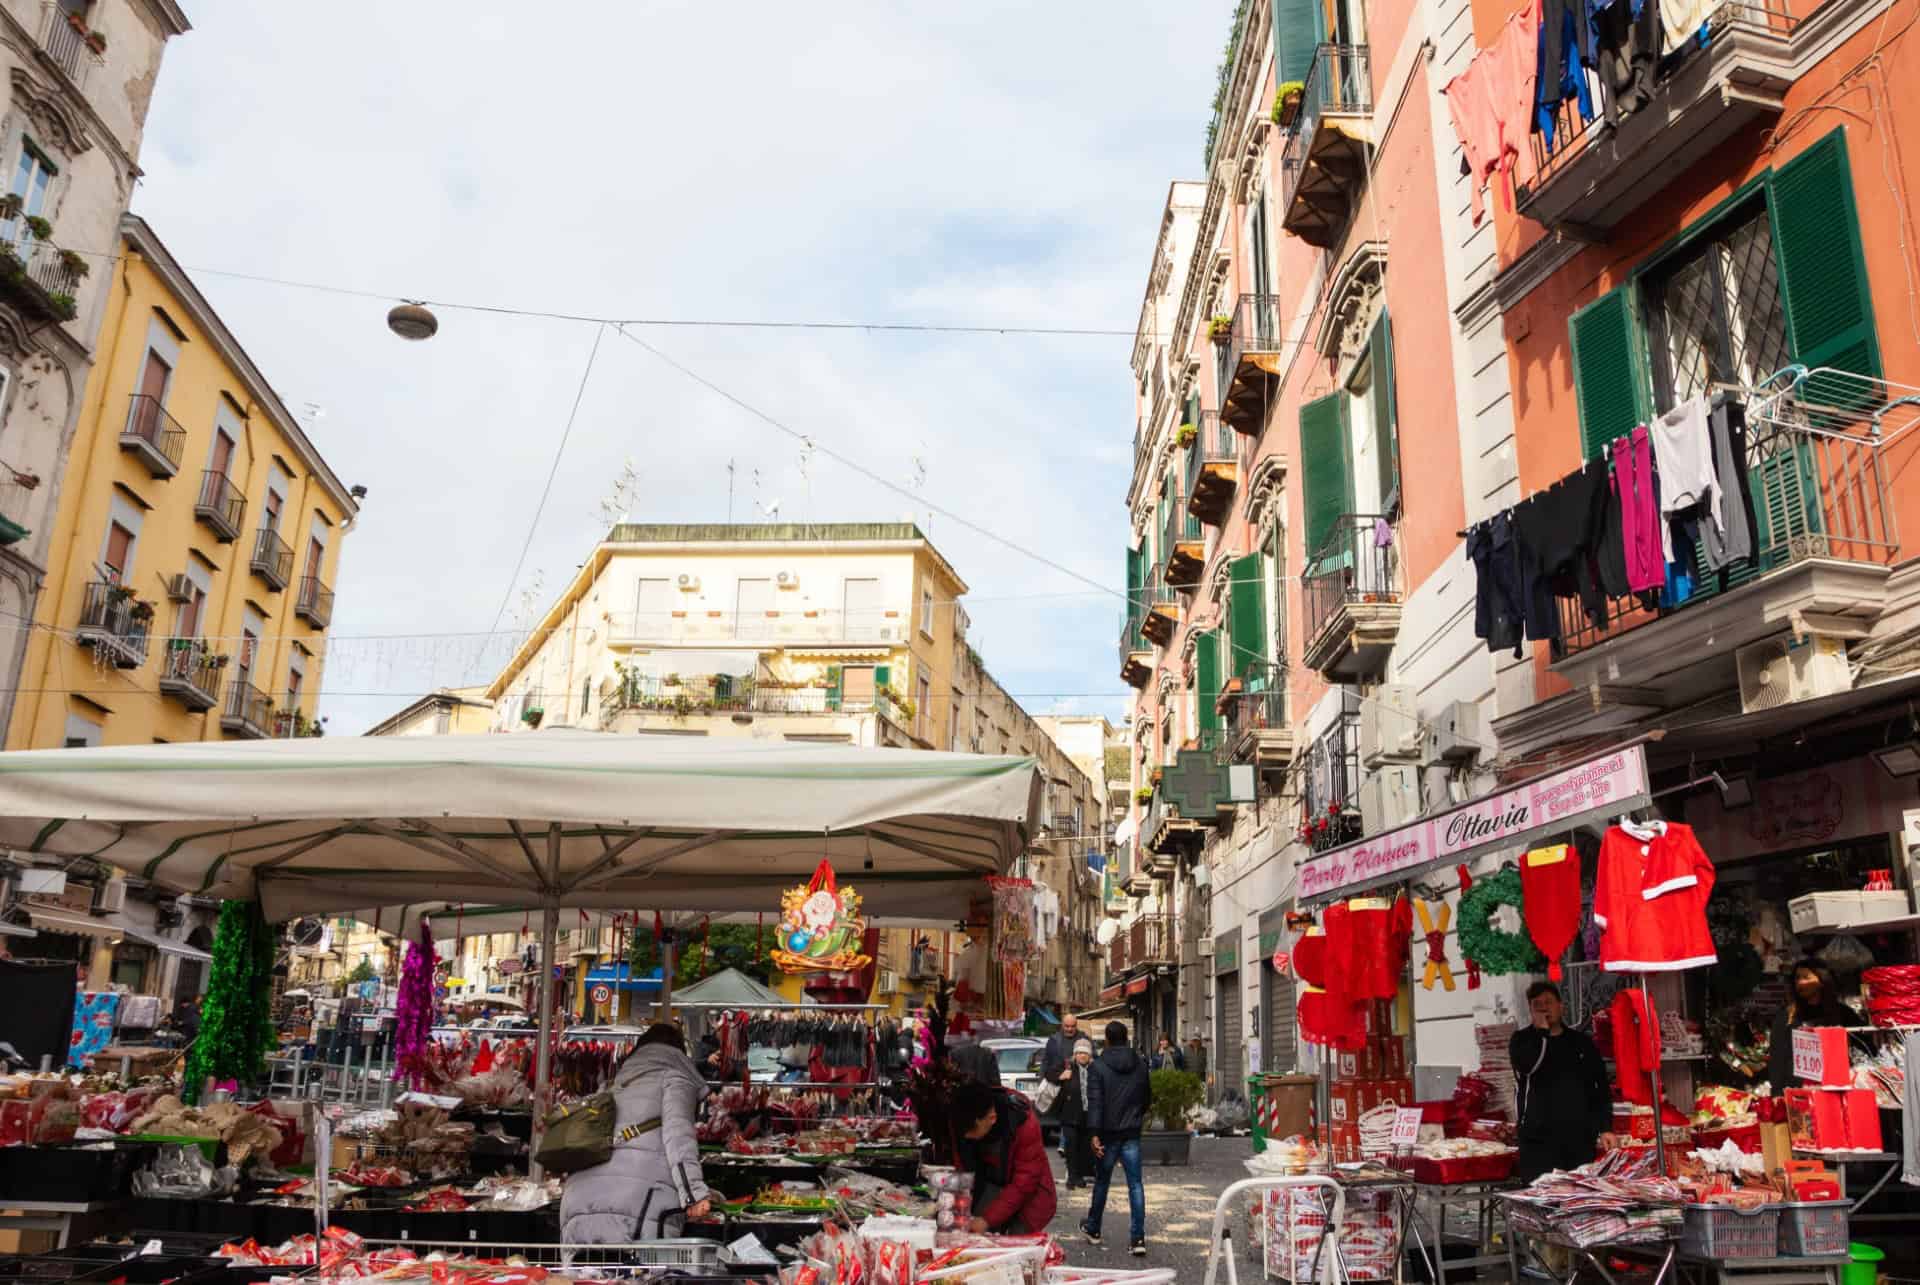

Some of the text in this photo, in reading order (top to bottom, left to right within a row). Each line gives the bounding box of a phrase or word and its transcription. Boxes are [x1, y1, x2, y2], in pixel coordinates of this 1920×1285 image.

[1446, 804, 1528, 846] Ottavia
[1303, 840, 1419, 888] Party Planner
